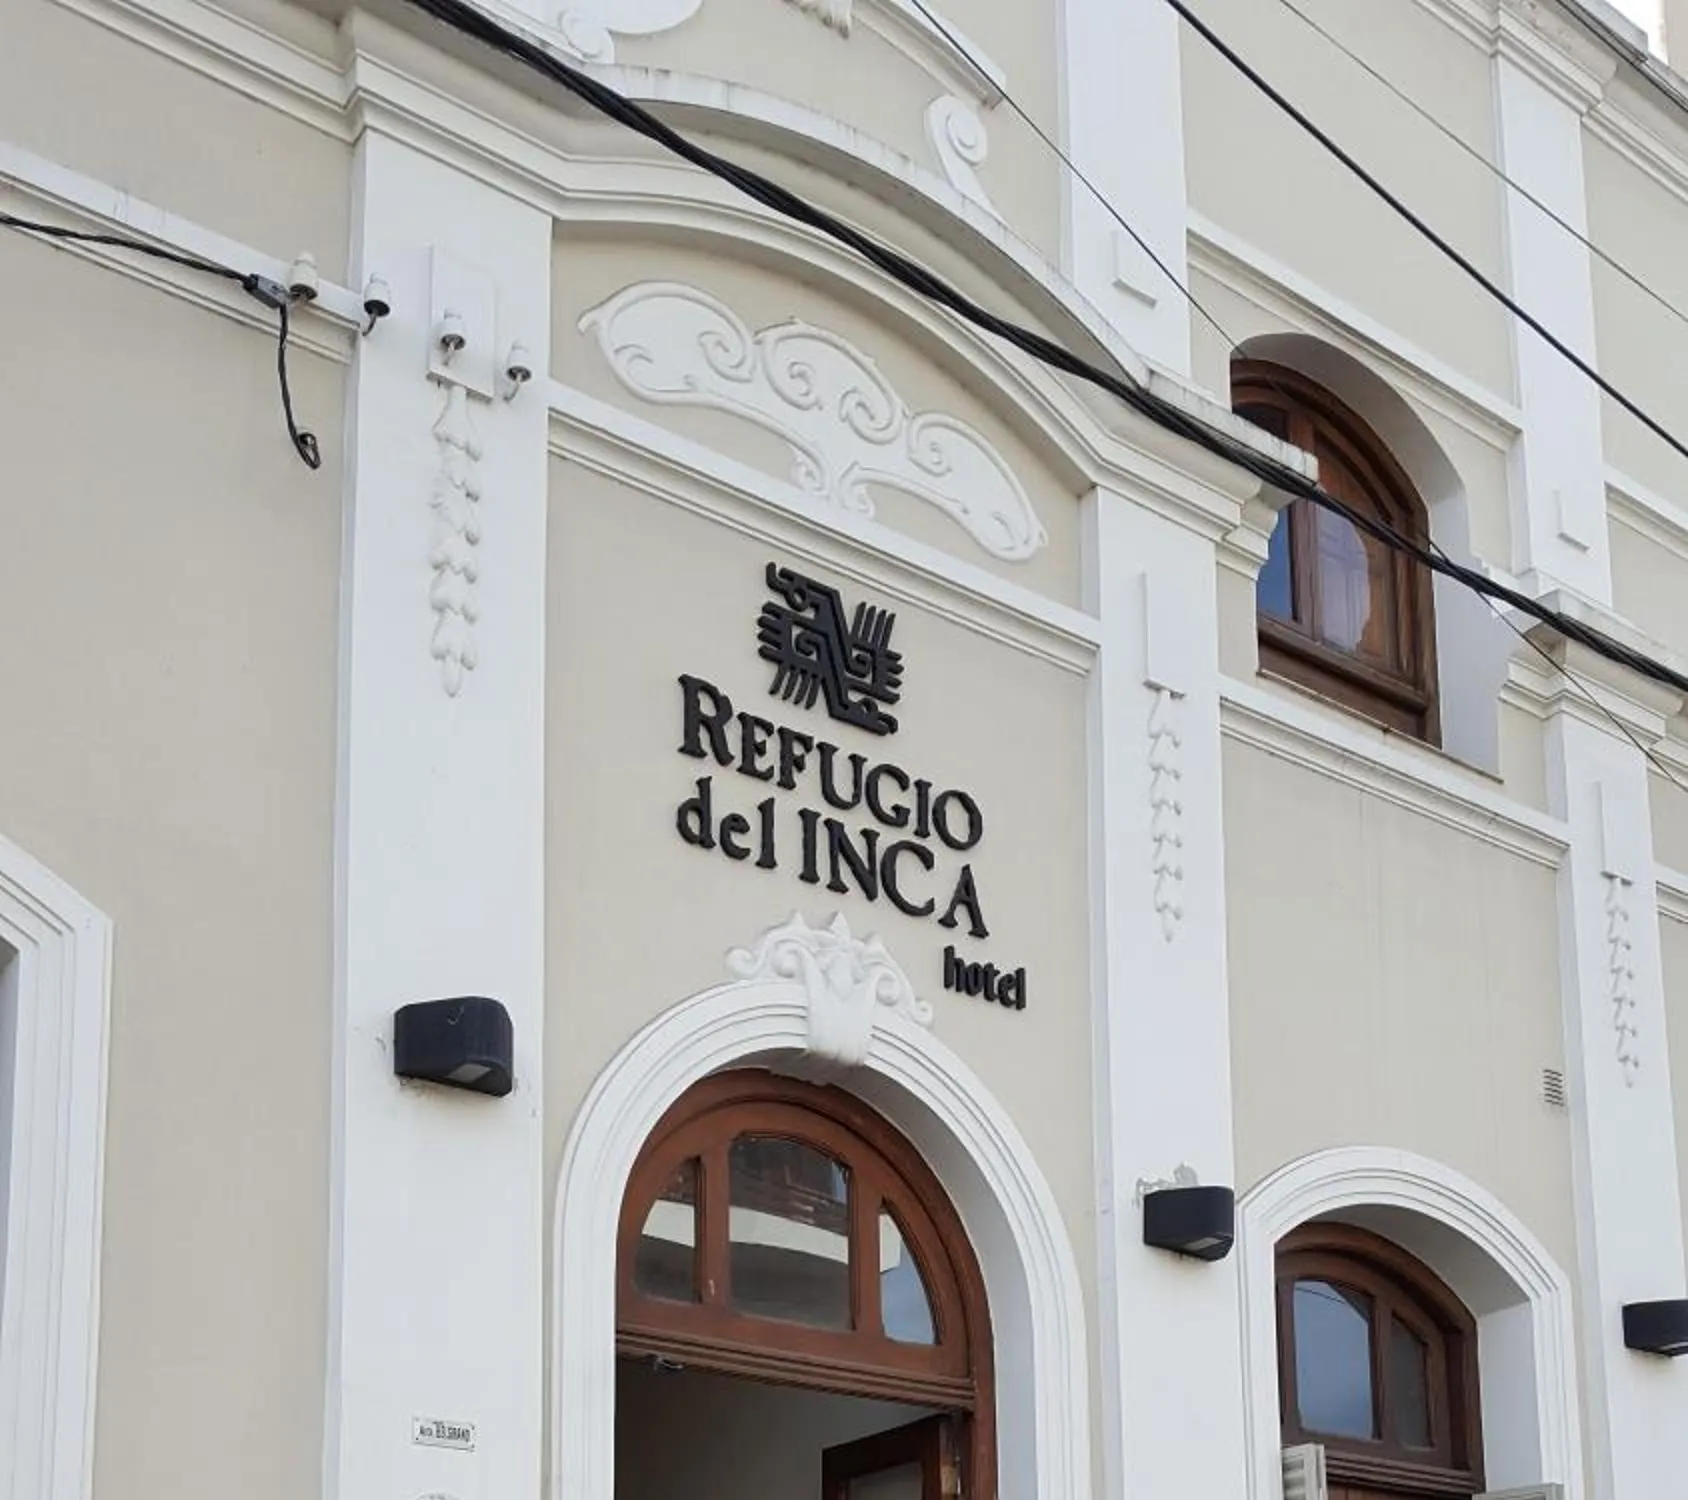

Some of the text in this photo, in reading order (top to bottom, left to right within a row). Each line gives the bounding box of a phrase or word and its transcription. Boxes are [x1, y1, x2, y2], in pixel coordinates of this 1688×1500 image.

[677, 672, 983, 851] REFUGIO
[675, 775, 989, 940] del INCA
[943, 945, 1026, 1010] hotel
